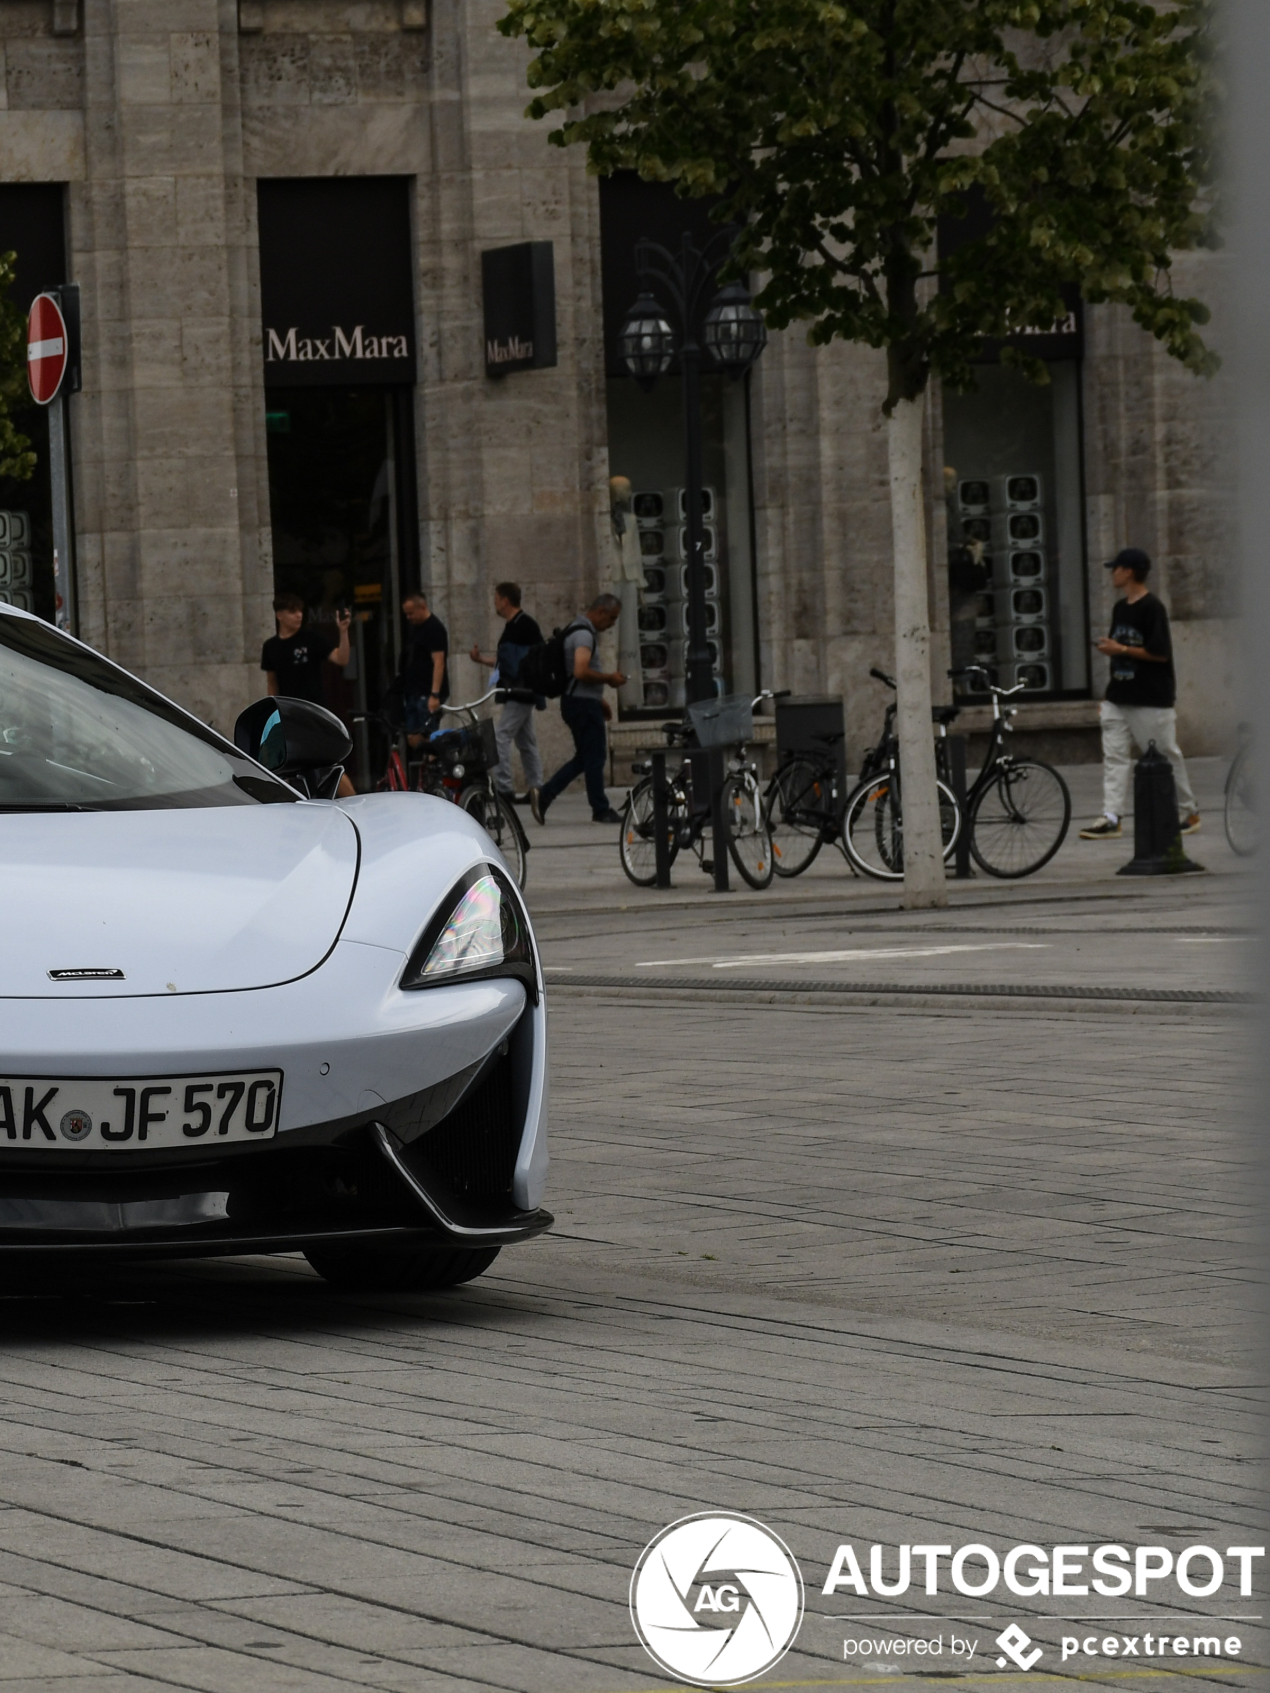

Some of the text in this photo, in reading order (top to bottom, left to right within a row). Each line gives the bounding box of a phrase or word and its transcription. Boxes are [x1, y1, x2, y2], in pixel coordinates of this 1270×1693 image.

[265, 324, 409, 364] MaxMara
[695, 541, 703, 552] 7
[100, 1086, 172, 1141] JF
[182, 1080, 276, 1138] 570
